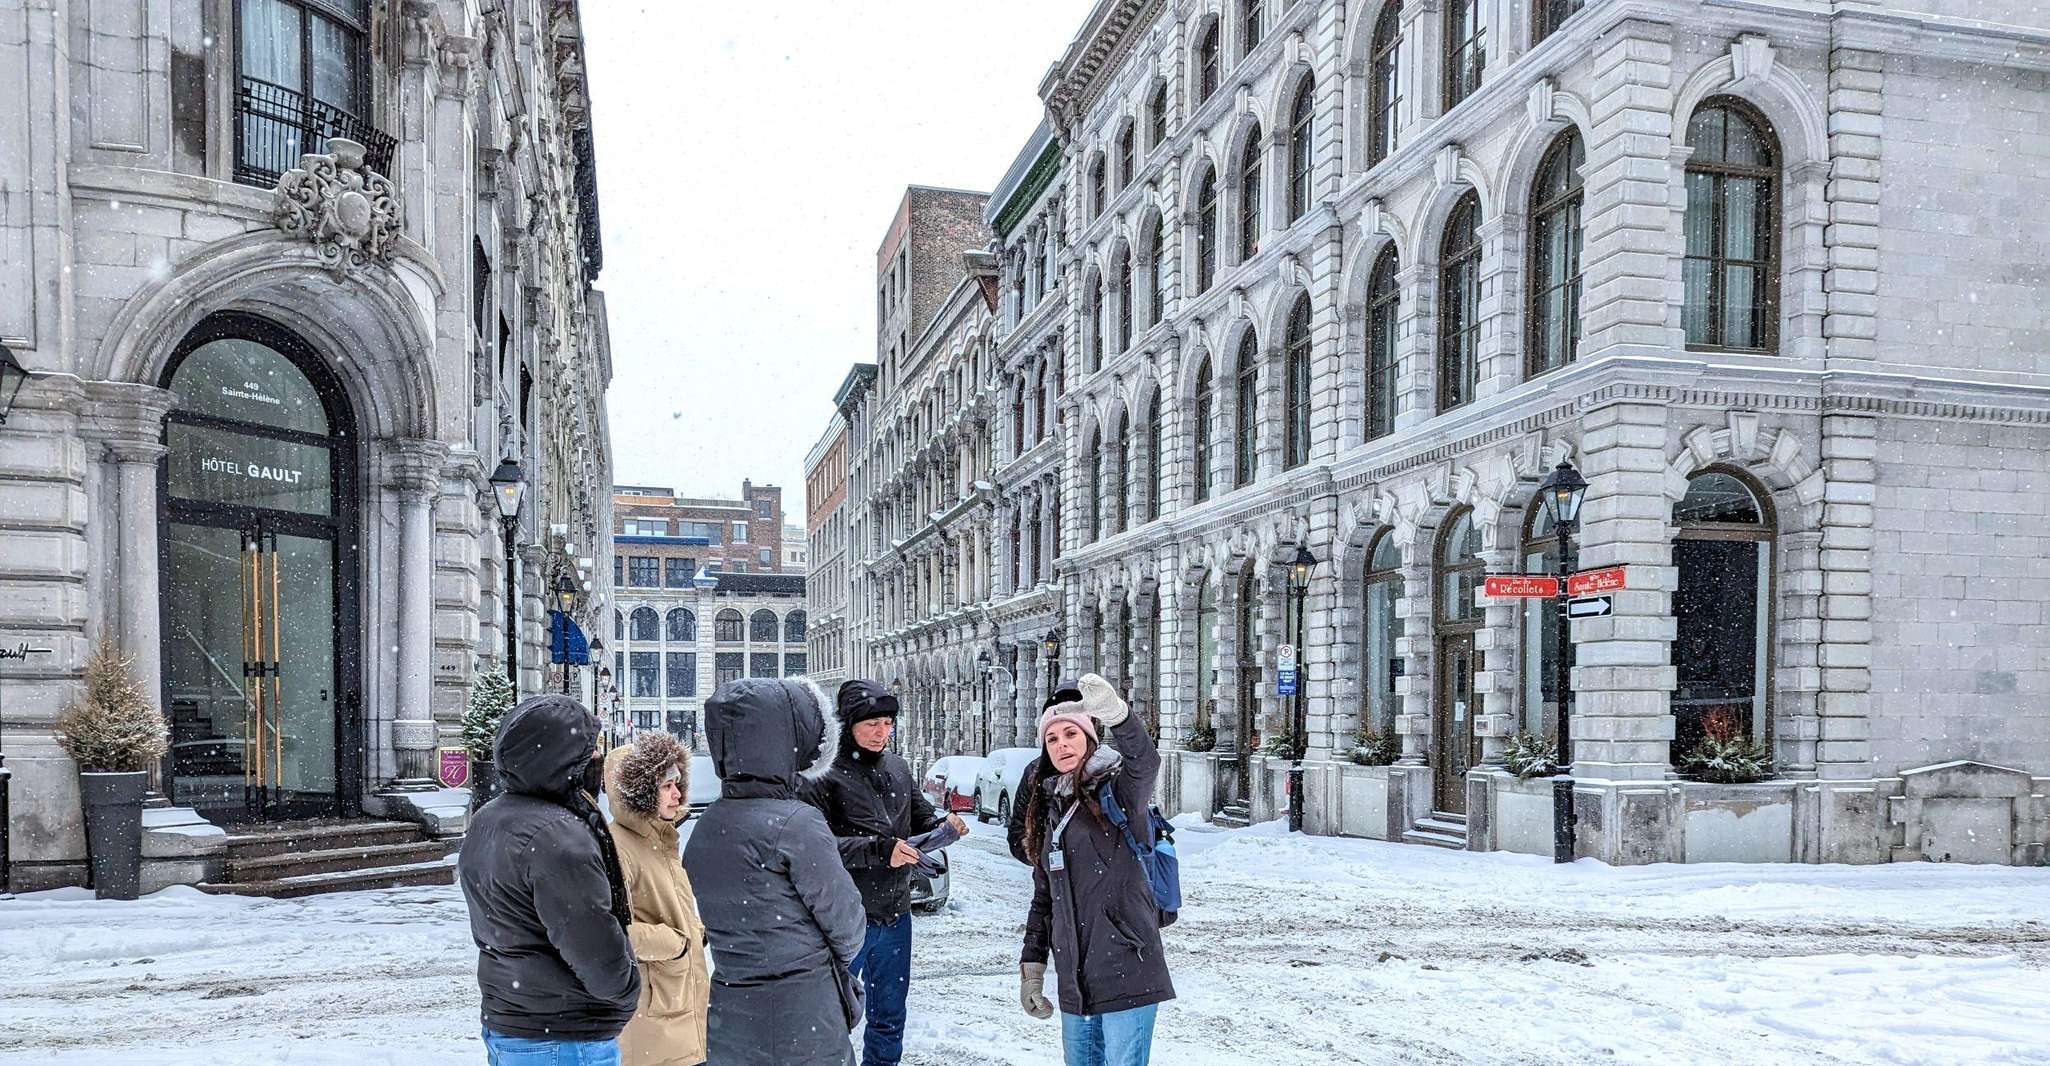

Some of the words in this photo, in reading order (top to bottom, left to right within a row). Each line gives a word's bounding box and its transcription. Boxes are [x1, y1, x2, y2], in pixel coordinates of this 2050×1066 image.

[243, 381, 259, 391] 449
[201, 457, 242, 475] HÔTEL
[247, 464, 302, 484] GAULT
[1500, 582, 1544, 594] Récollets
[0, 641, 52, 662] ault
